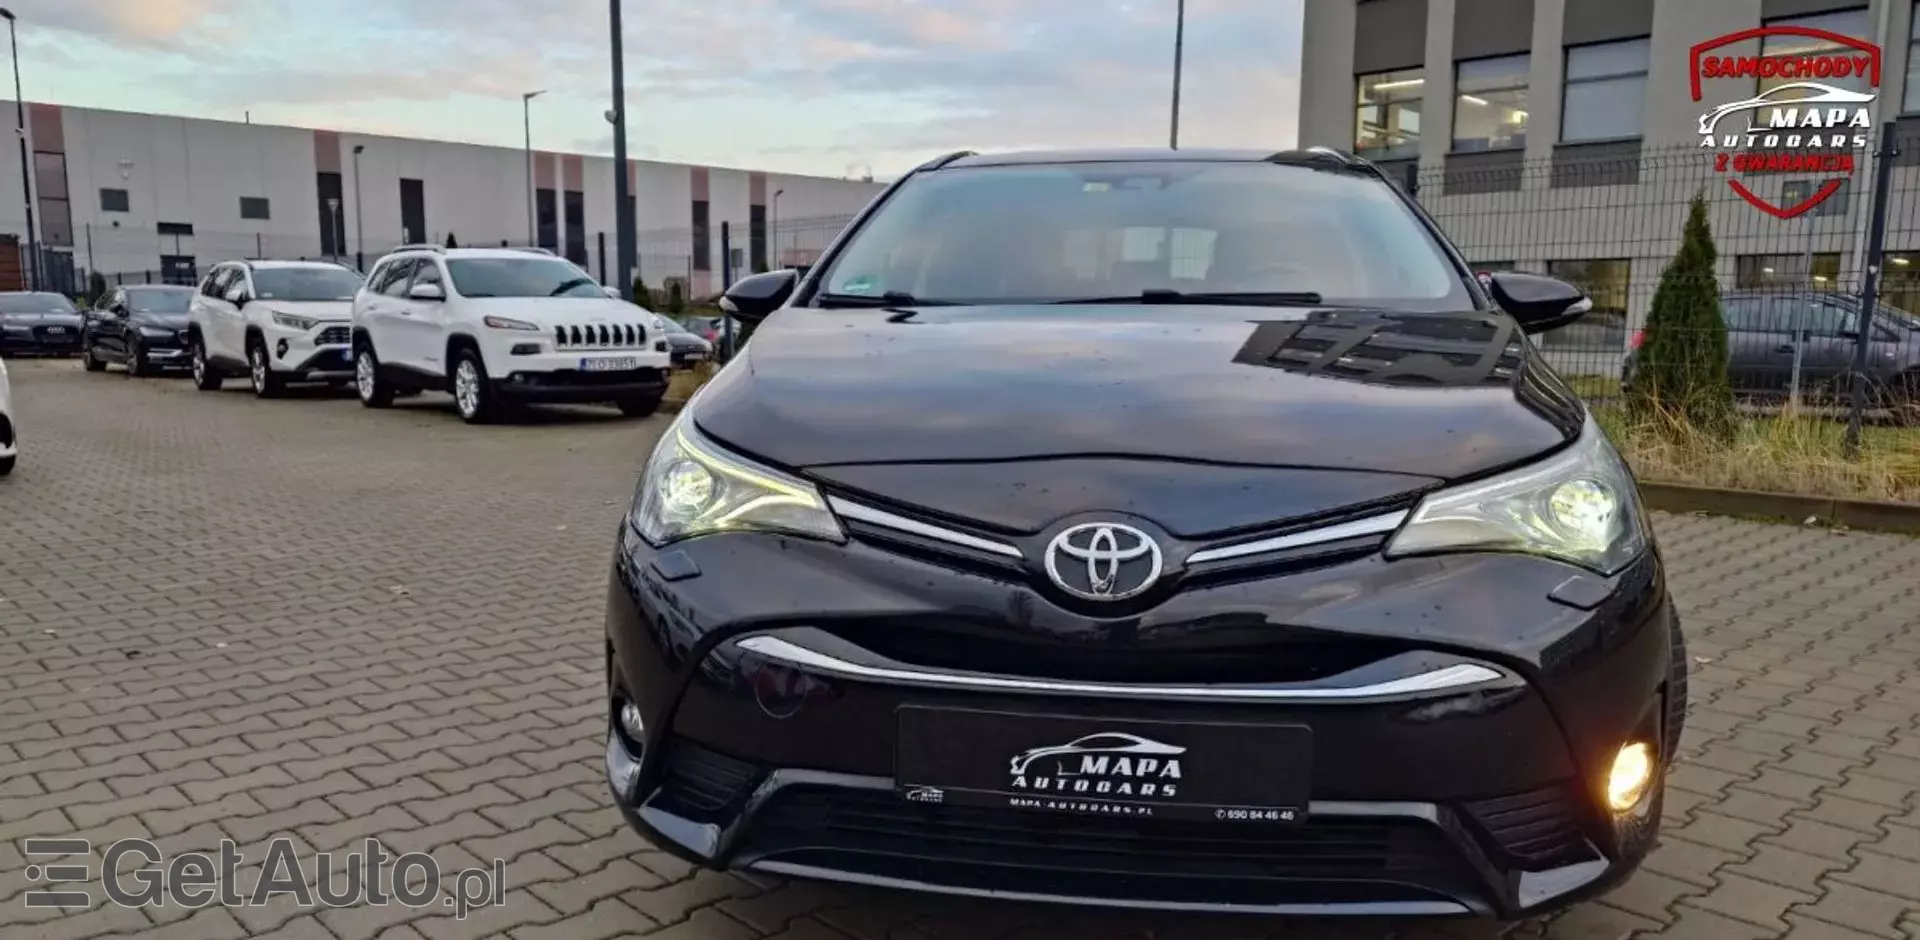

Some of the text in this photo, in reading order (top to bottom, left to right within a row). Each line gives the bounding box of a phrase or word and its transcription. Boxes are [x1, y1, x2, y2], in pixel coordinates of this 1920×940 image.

[1079, 754, 1182, 779] MAPA
[1011, 775, 1178, 797] AUTOCARS
[1227, 809, 1248, 819] 690
[1249, 810, 1263, 820] 84
